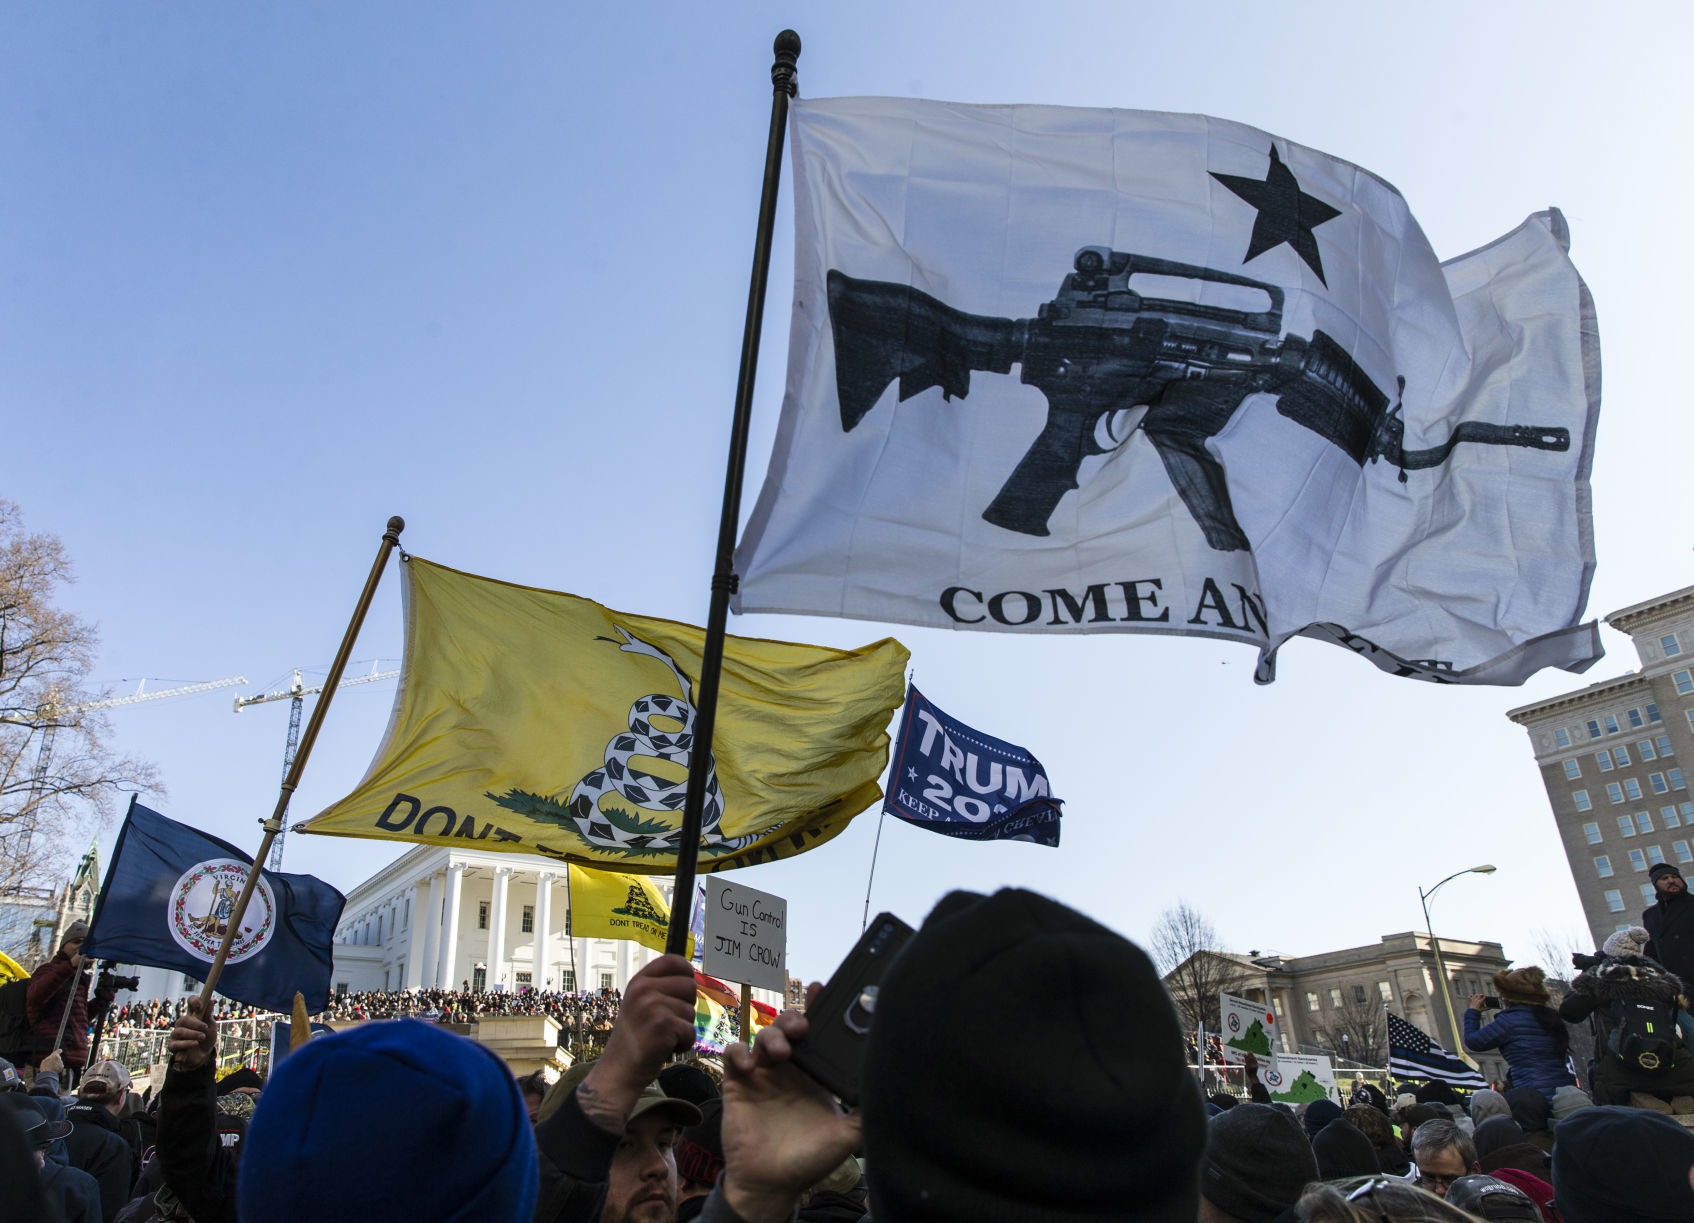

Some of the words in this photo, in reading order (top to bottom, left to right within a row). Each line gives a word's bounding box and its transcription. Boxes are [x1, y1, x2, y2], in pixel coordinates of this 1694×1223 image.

[940, 578, 1170, 626] COME
[1187, 577, 1271, 641] AN
[918, 709, 1050, 803] TRUM
[898, 788, 940, 820] KEEP
[213, 874, 246, 884] VIRGIN
[720, 888, 748, 916] Gun
[752, 900, 784, 929] Control
[609, 918, 629, 927] DONT
[632, 920, 649, 932] TREAD
[740, 921, 757, 937] IS
[714, 935, 741, 959] JIM
[749, 943, 781, 968] CROW
